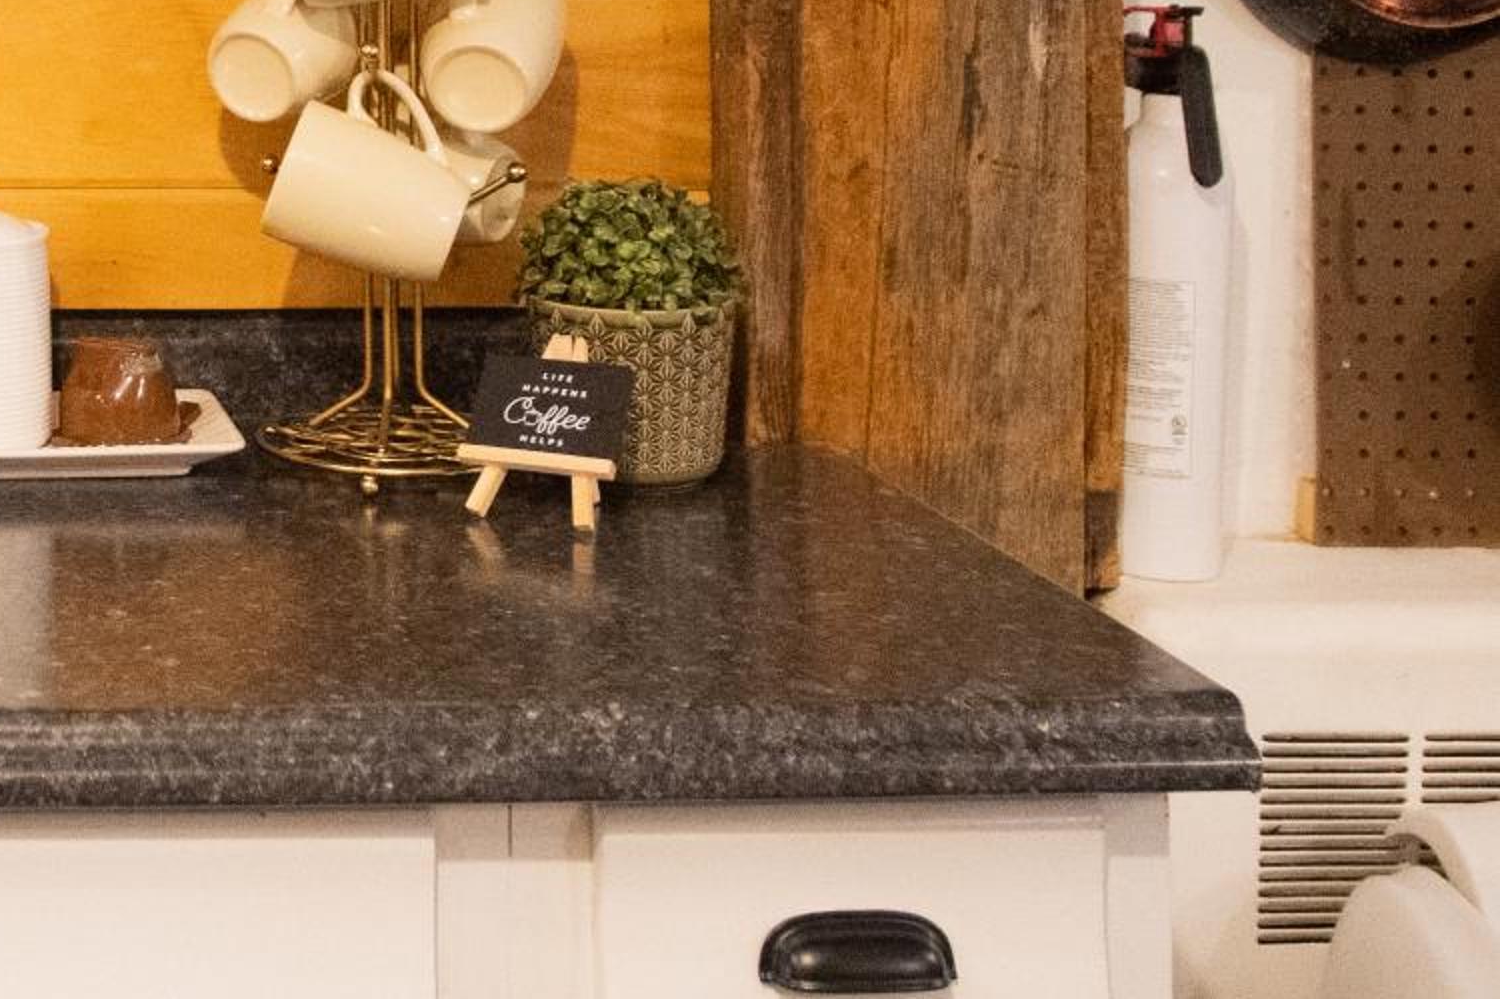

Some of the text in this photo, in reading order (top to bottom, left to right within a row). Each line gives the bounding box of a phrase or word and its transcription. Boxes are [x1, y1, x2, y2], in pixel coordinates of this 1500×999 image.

[541, 371, 574, 384] LIFE
[521, 383, 588, 399] HAPPENS
[503, 395, 592, 436] Coffee
[519, 433, 564, 448] HELPS
